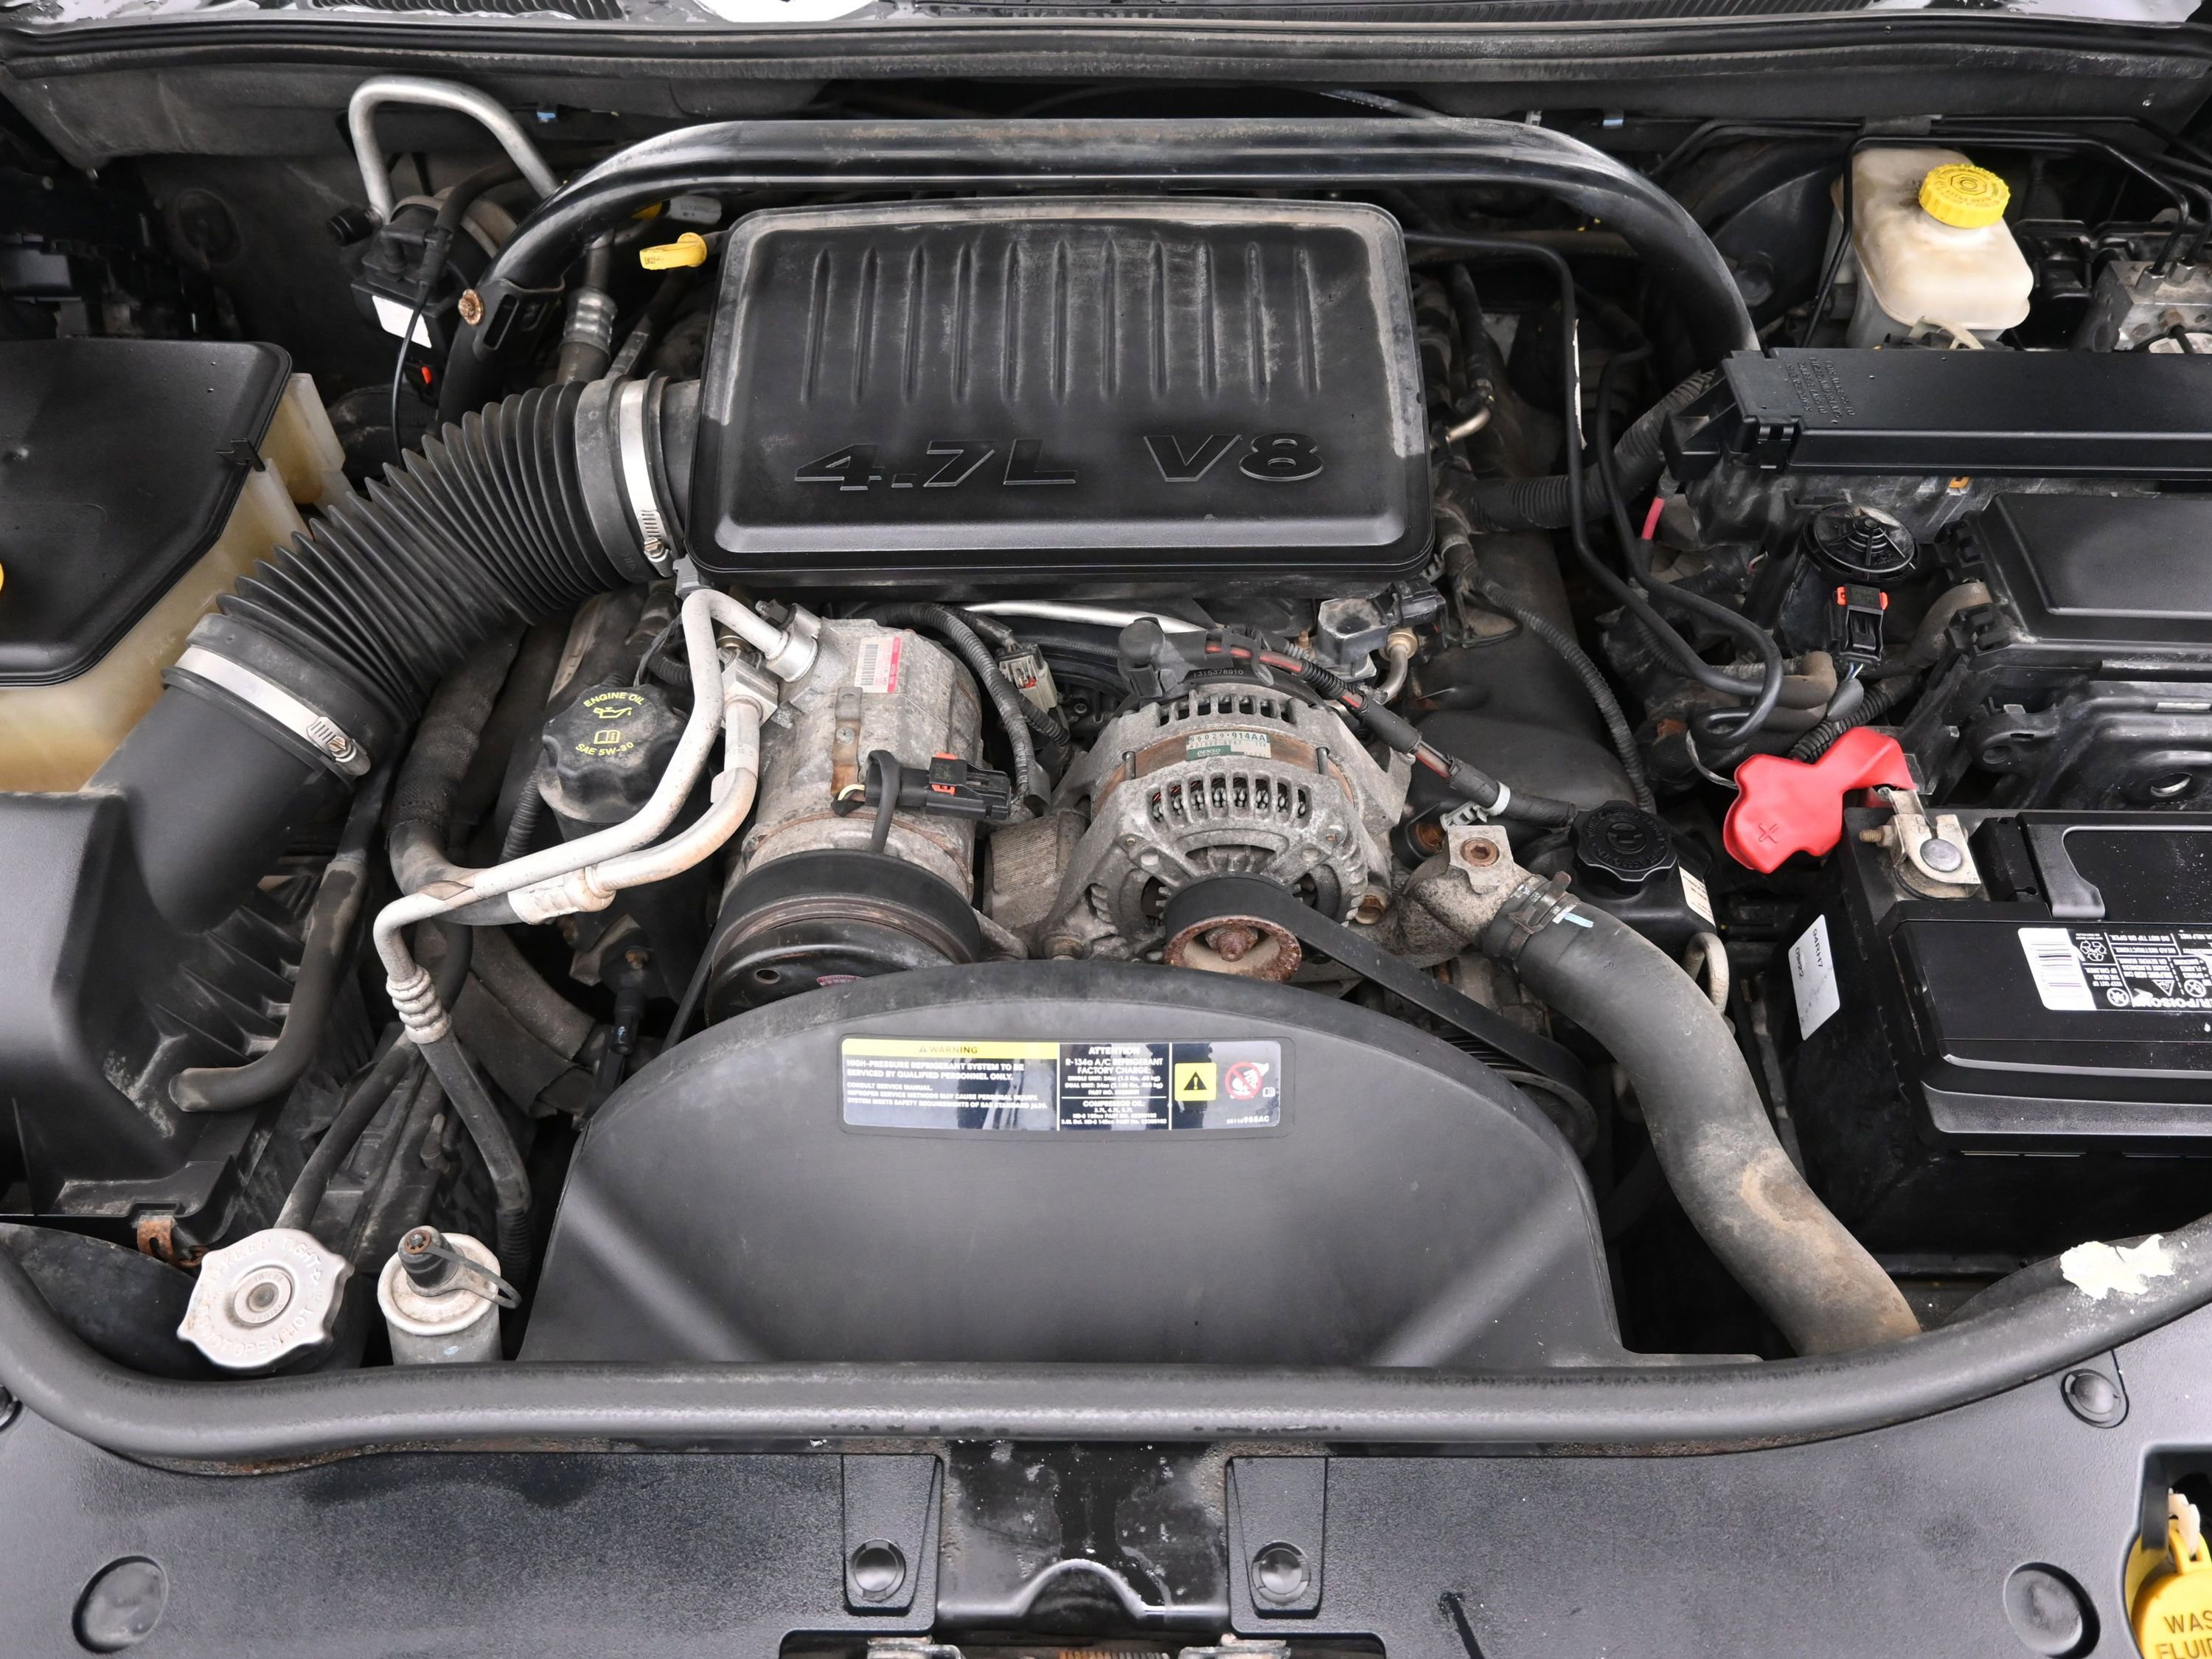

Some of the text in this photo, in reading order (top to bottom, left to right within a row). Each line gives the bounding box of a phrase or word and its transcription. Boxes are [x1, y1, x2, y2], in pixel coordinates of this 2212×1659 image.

[795, 433, 1324, 490] 4.7L V8
[583, 692, 644, 707] ENGINE OIL
[576, 742, 634, 756] SAE 5W-30
[1812, 928, 1823, 967] 94RH7
[930, 1046, 978, 1054] WARNING
[1088, 1047, 1141, 1055] ATTENTION
[847, 1060, 909, 1068] HIGH-PRESSURE
[910, 1061, 965, 1070] REFRIGERANT
[967, 1062, 999, 1071] SYSTEM
[1013, 1063, 1025, 1071] BE
[1065, 1058, 1164, 1066] R-134a A/C REFRIGERANT
[847, 1068, 884, 1077] SERVICED
[886, 1070, 896, 1078] BY
[897, 1071, 939, 1079] QUALIFIED
[940, 1071, 989, 1080] PERSONNEL
[225, 1238, 321, 1268] KEEP TIGHT
[199, 1330, 232, 1354] NOT
[234, 1332, 285, 1358] OPEN
[285, 1302, 316, 1339] HOT
